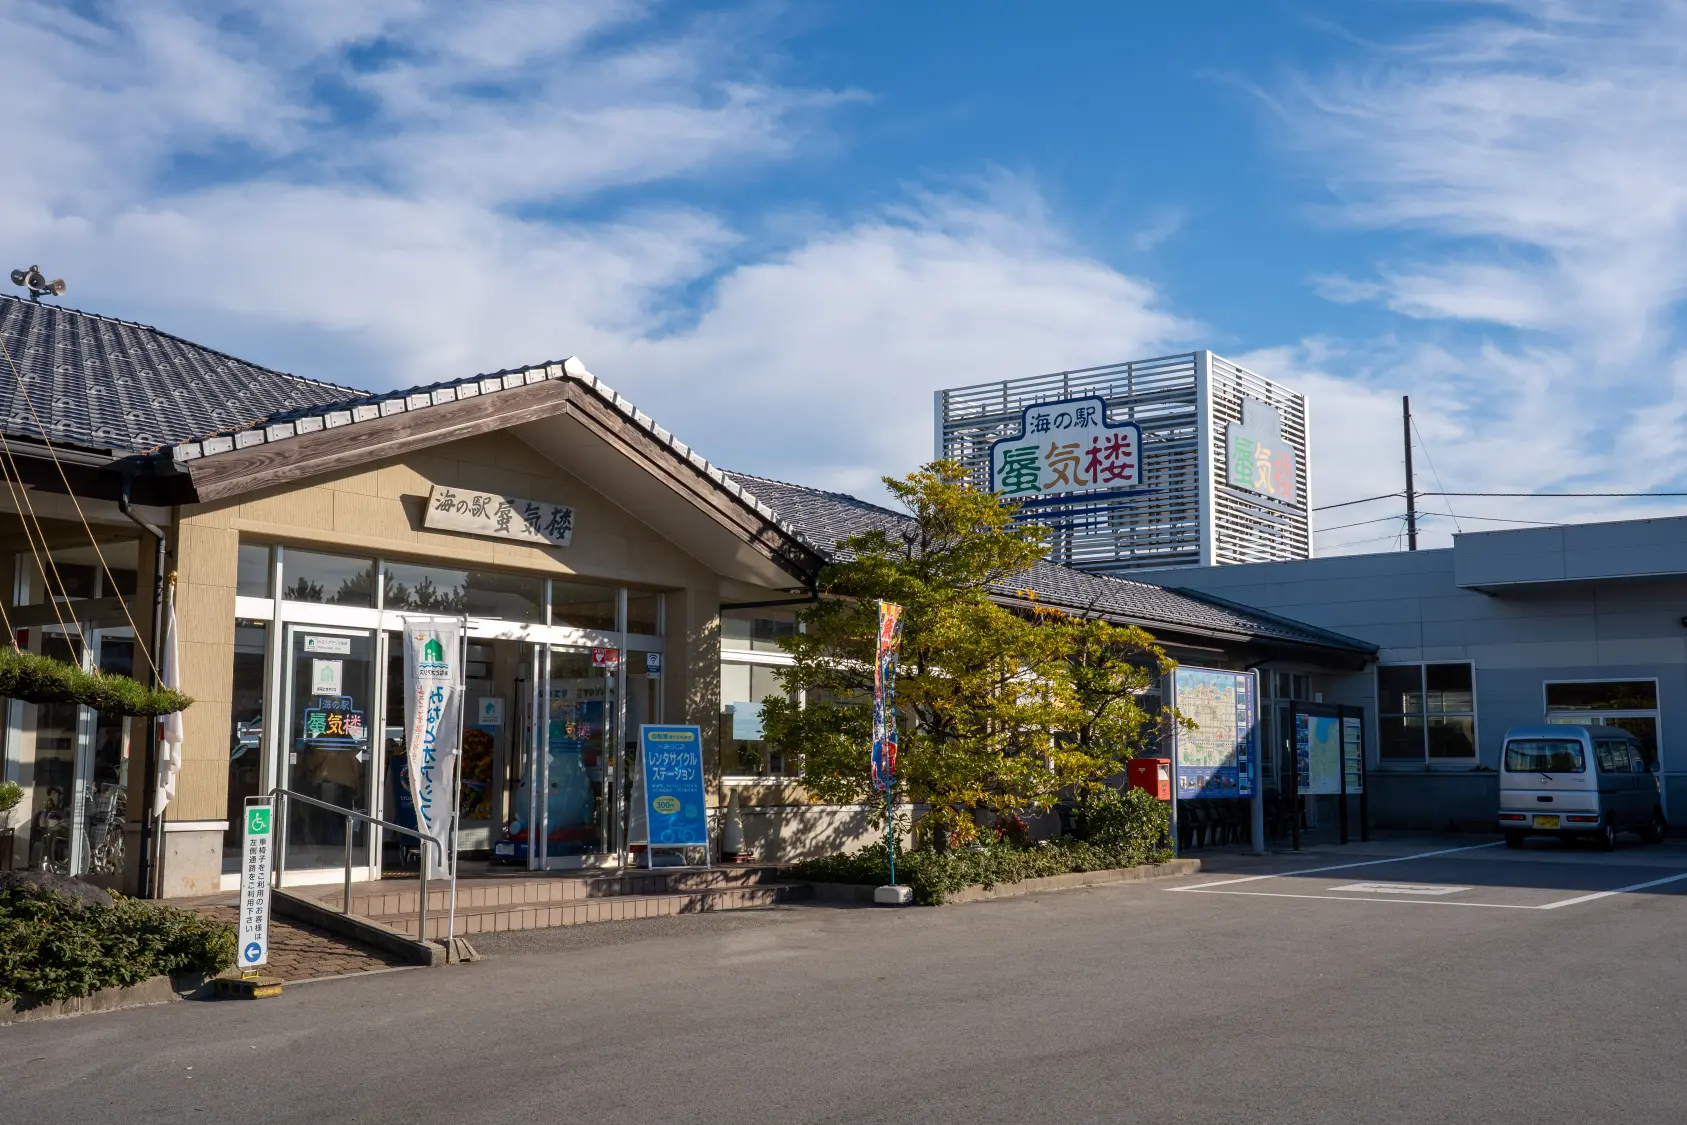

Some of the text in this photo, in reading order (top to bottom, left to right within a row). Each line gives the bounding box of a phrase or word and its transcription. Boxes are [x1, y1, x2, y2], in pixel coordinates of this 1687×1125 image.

[1030, 405, 1098, 434] 海の駅
[996, 432, 1136, 497] 蜃気楼
[1232, 435, 1295, 500] 蜃気楼
[307, 712, 362, 735] 蜃気楼
[648, 751, 698, 767] レンタサイクル
[652, 766, 696, 782] ステーション
[245, 840, 257, 932] 左側通路をご利用下さい
[254, 839, 267, 940] 車椅子をご利用のお客様は
